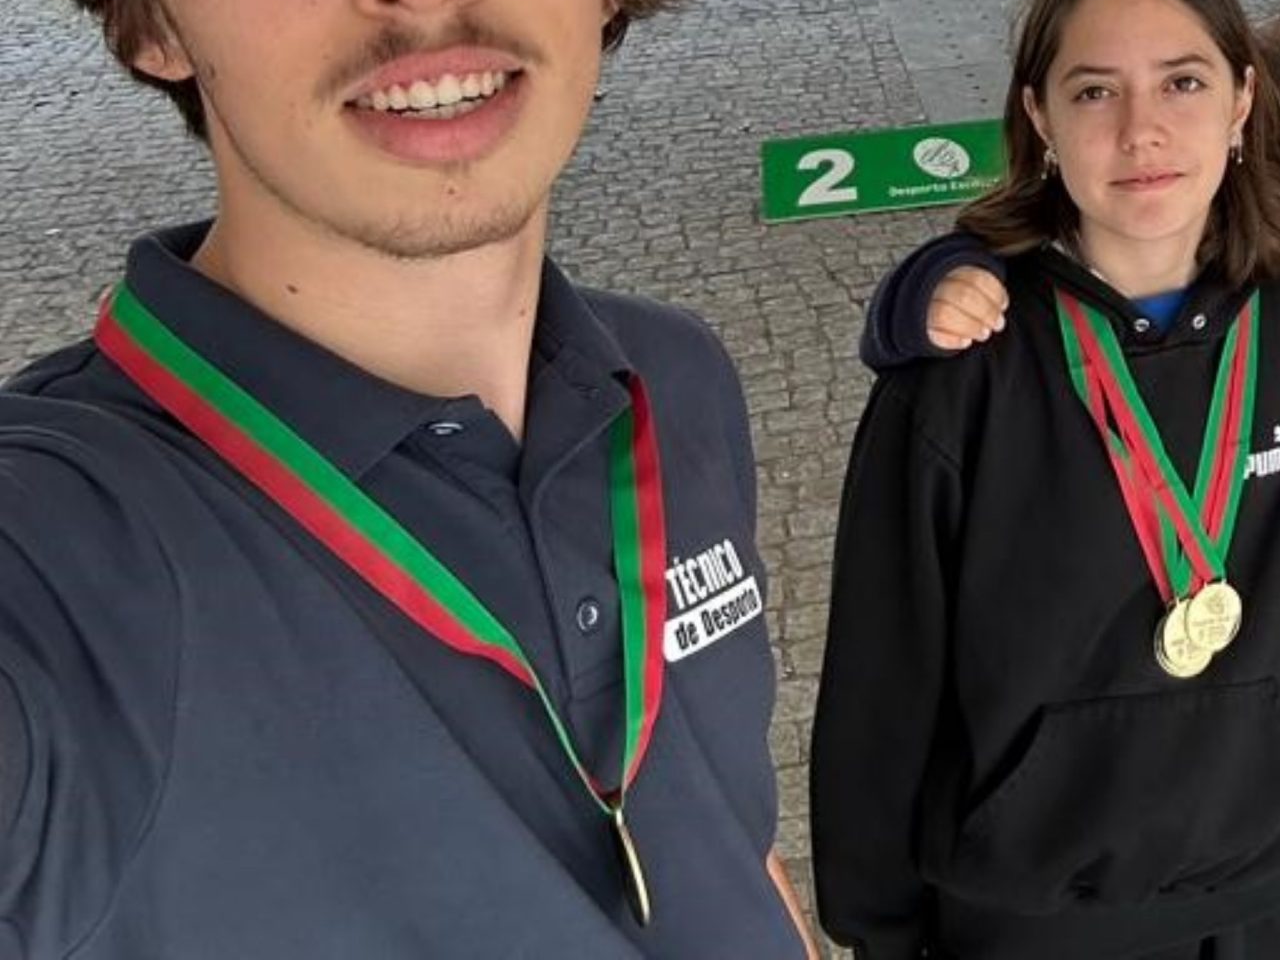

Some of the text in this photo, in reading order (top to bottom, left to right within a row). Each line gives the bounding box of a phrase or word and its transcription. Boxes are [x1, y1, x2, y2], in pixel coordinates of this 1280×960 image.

[797, 148, 858, 207] 2
[664, 538, 744, 610] TÉCNICO
[674, 587, 758, 651] de Desporto
